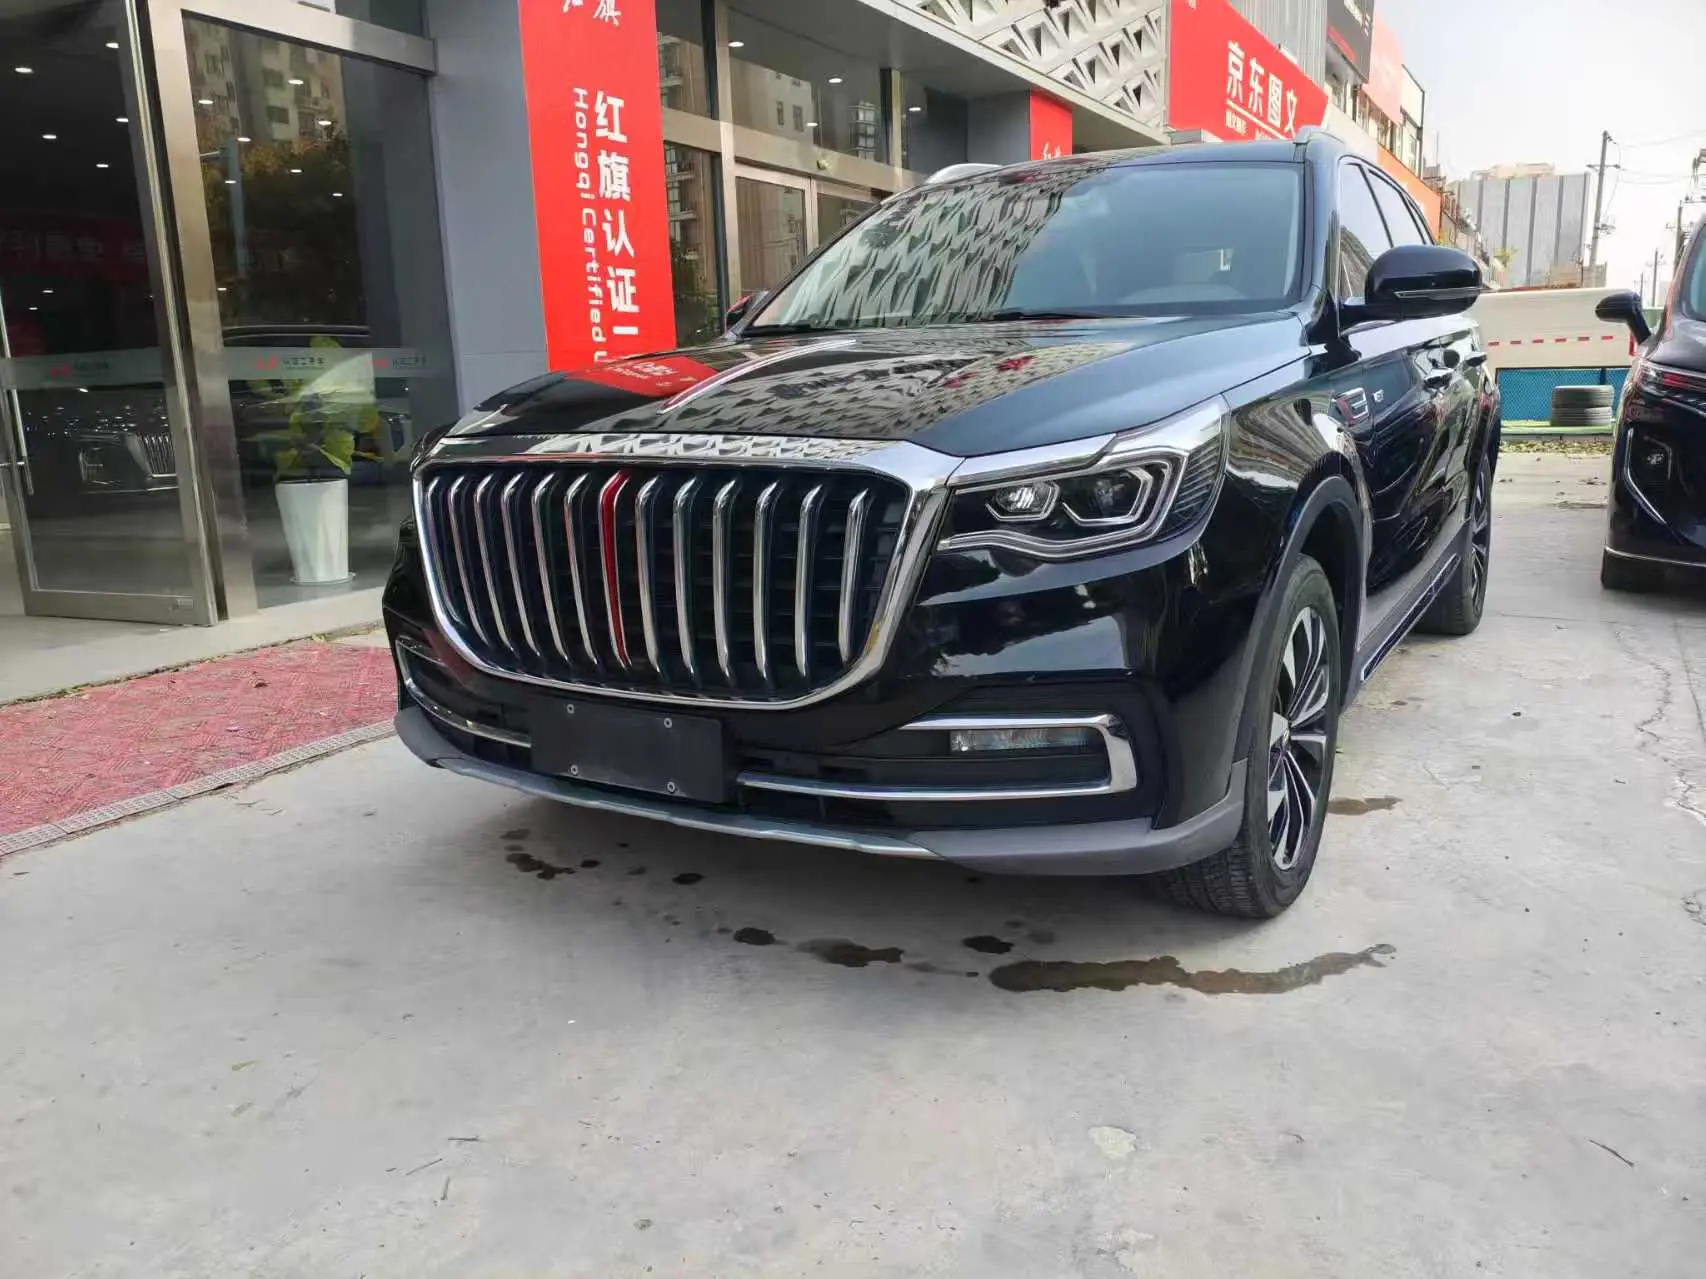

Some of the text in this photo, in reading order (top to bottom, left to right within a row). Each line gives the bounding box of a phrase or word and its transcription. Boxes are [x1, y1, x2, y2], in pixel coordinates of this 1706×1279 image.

[573, 87, 596, 199] Hongqi
[1226, 40, 1298, 140] 京东图文
[582, 207, 607, 342] Certified
